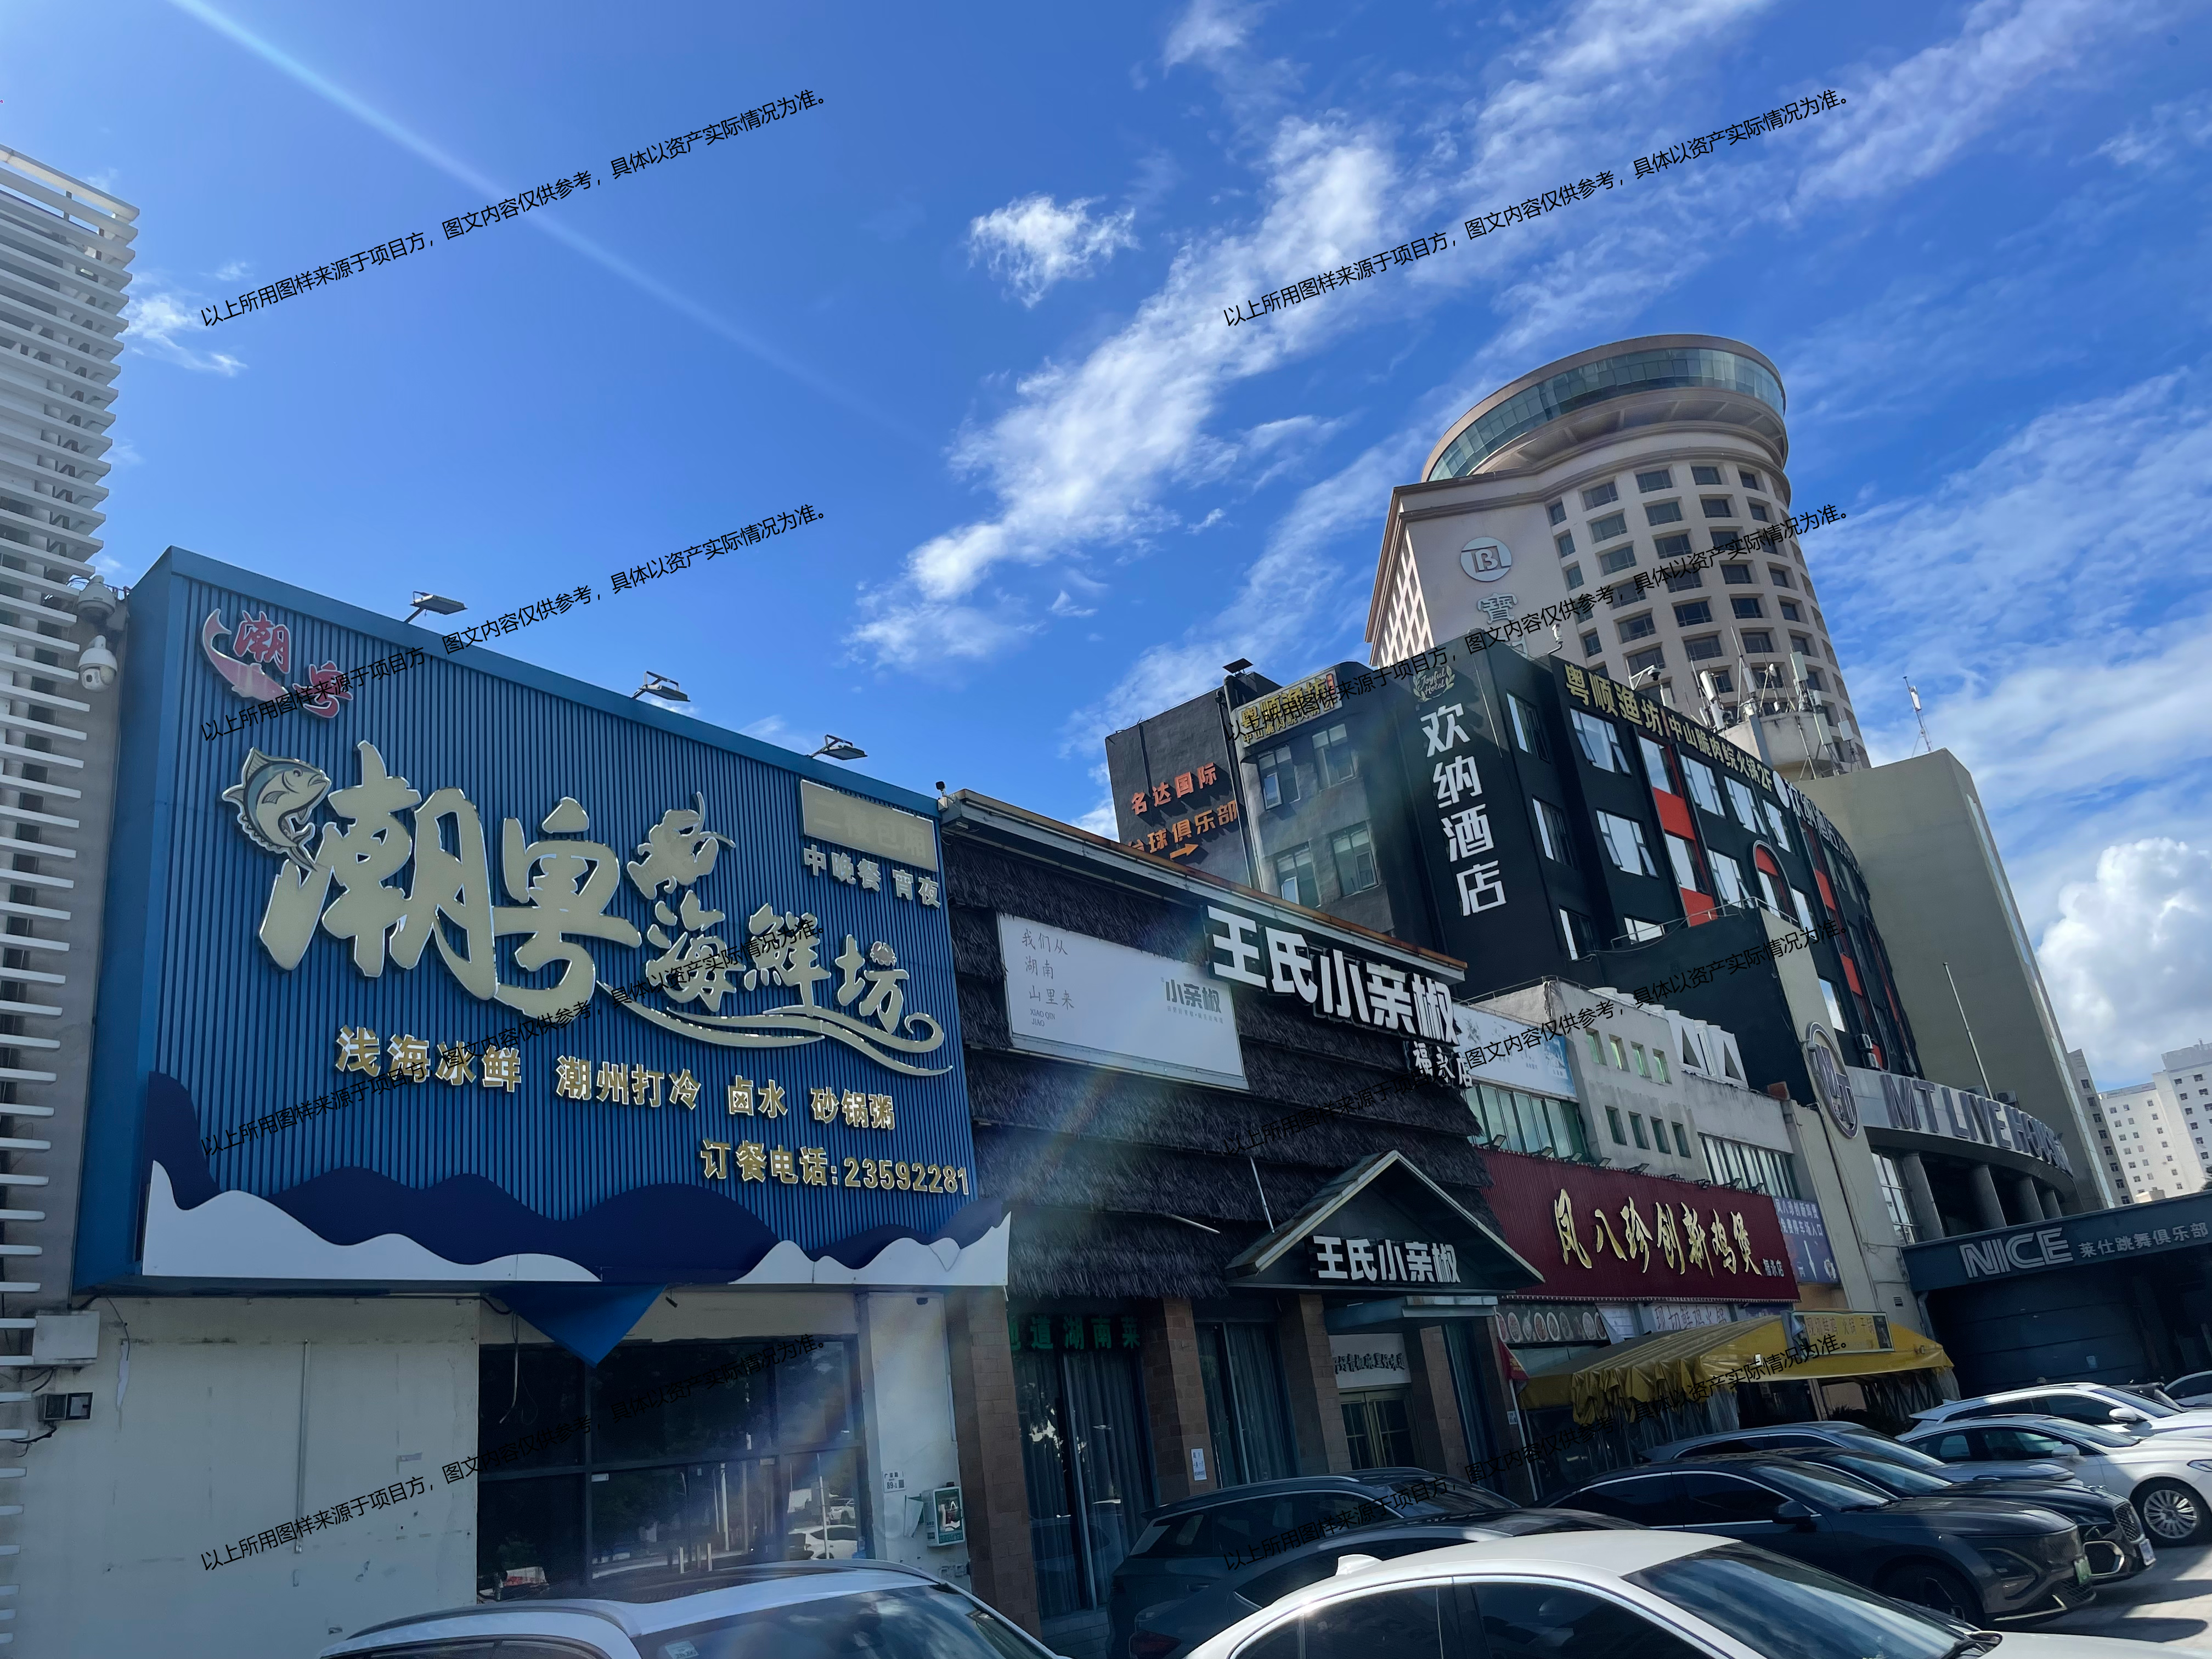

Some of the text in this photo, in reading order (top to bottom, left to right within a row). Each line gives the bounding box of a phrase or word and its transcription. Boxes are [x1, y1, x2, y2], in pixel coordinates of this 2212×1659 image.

[1418, 668, 1446, 691] Joyful
[1425, 679, 1445, 695] Hotel
[1131, 763, 1217, 816] 名达国际
[1420, 703, 1507, 916] 欢纳酒店
[804, 844, 941, 909] 中晚餐 宵夜
[644, 890, 912, 1035] 海鲜坊
[1022, 928, 1068, 955] 我们从
[1025, 955, 1054, 979] 湖南
[1207, 905, 1459, 1046] 王氏小亲椒
[1029, 985, 1075, 1011] 山里来
[1030, 1008, 1056, 1020] XIAO QIN
[1031, 1018, 1045, 1027] JIAO
[335, 1025, 522, 1092] 浅海冰鲜
[556, 1055, 701, 1110] 潮州打冷
[810, 1087, 895, 1130] 砂锅粥
[1413, 1041, 1474, 1089] 福永店
[1880, 1074, 1939, 1132] MT
[1942, 1087, 2012, 1149] LIVE
[701, 1137, 970, 1197] 订餐电话:23592281
[1313, 1235, 1461, 1284] 王氏小亲椒
[1959, 1227, 2073, 1278] NICE
[2077, 1221, 2209, 1259] 莱仕跳舞俱乐部
